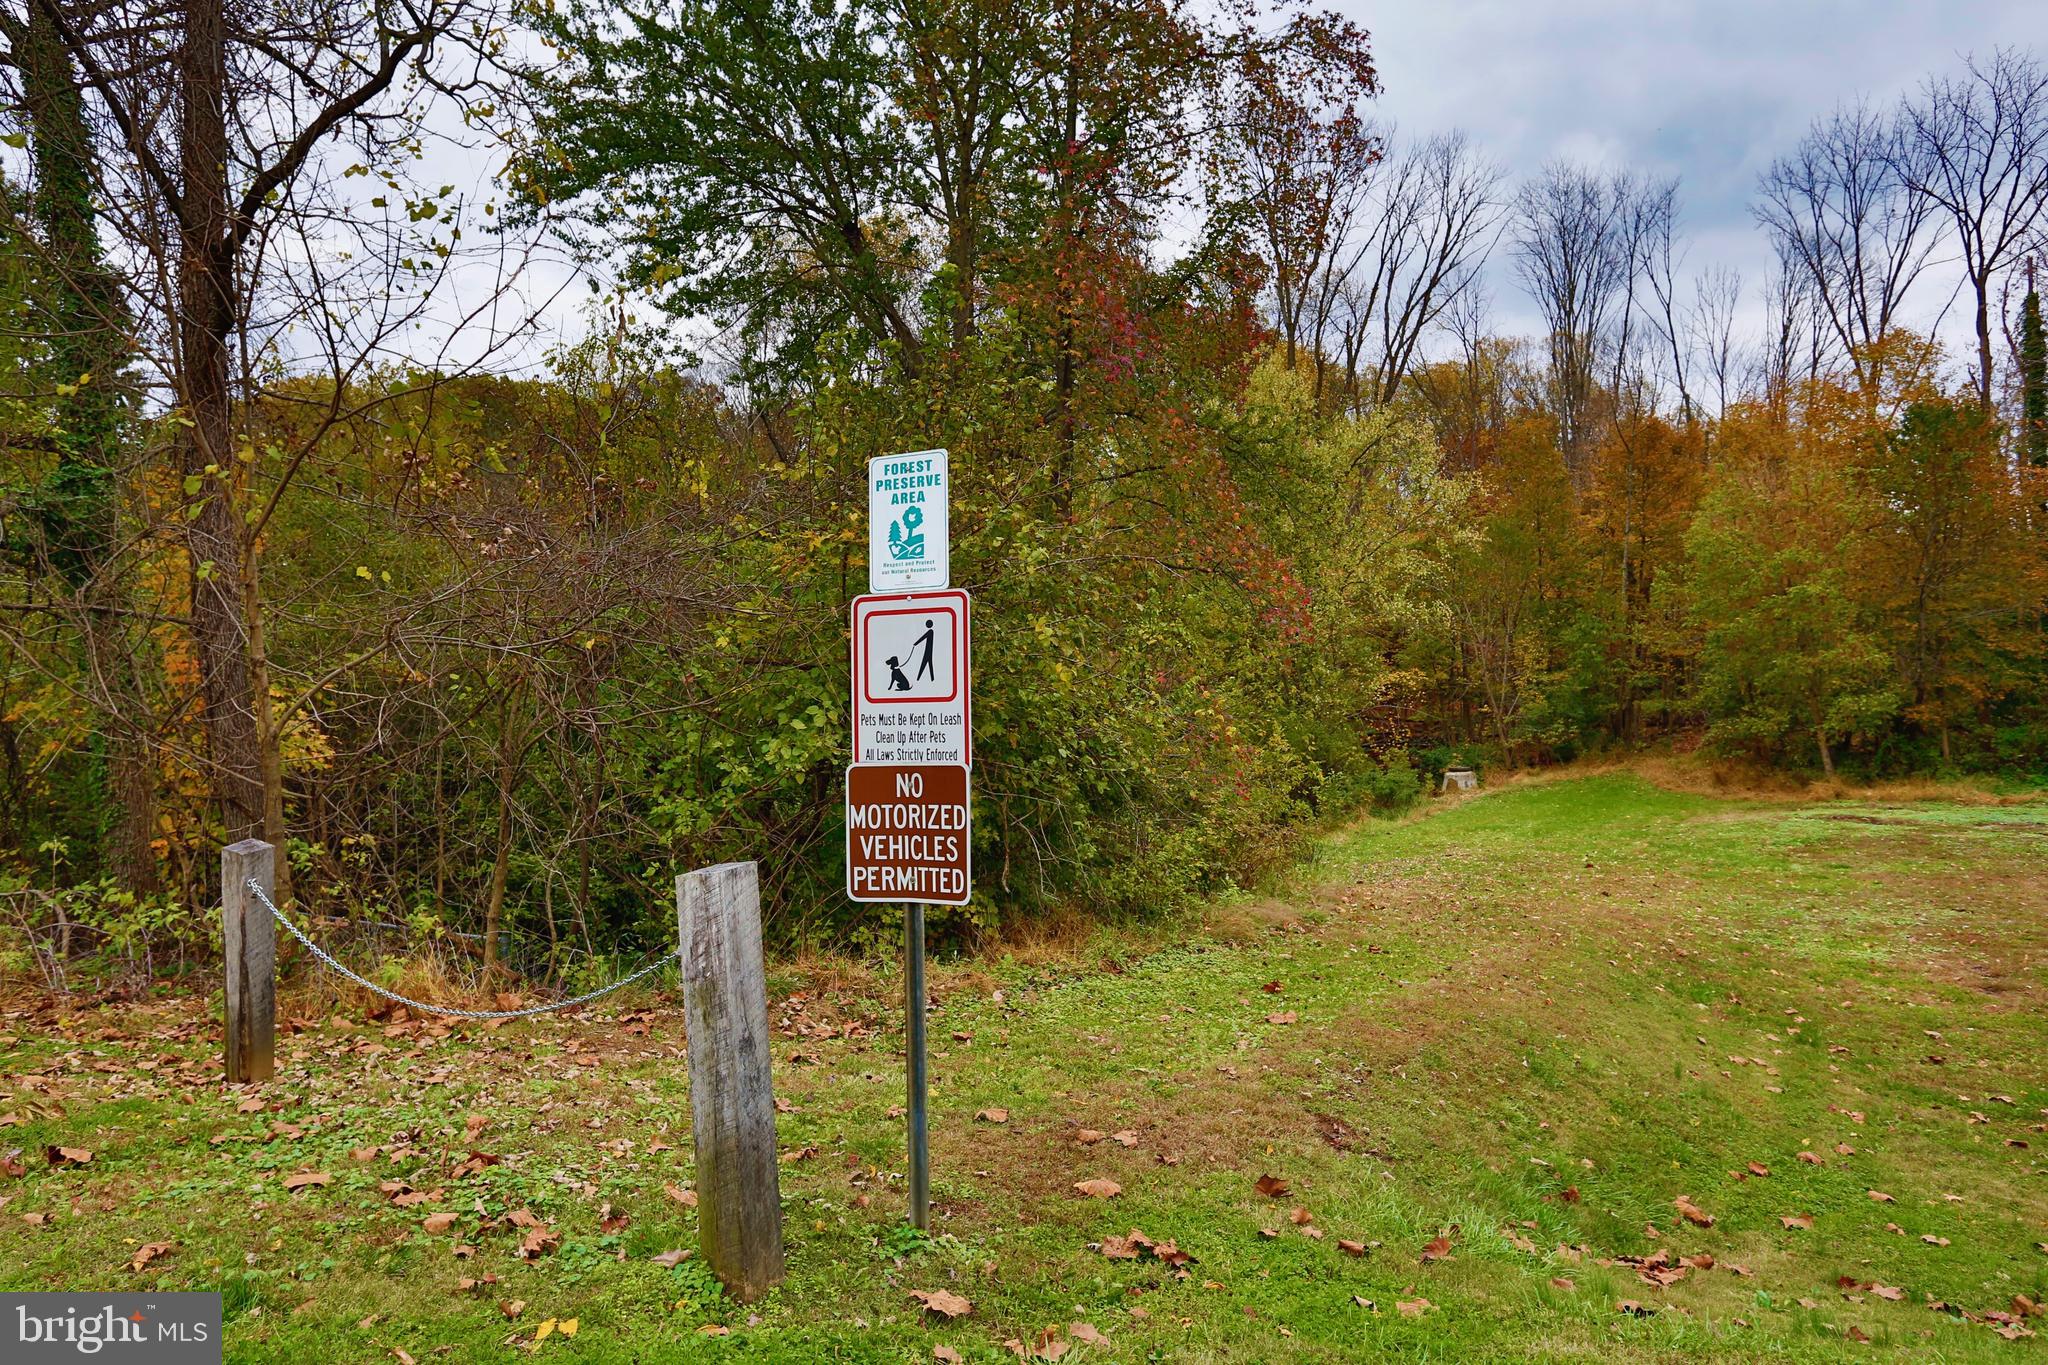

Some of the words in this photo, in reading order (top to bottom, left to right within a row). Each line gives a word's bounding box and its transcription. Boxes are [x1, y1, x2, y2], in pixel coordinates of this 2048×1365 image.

[884, 459, 933, 476] FOREST
[876, 473, 941, 492] PRESERVE
[891, 490, 926, 505] AREA
[860, 714, 876, 726] Pets
[879, 713, 895, 726] Must
[898, 713, 907, 726] Be
[910, 713, 925, 728] Kept
[928, 713, 938, 726] On
[940, 713, 962, 726] Leash
[876, 731, 895, 743] Clean
[897, 731, 906, 746] Up
[909, 730, 927, 743] After
[930, 731, 946, 743] Pets
[865, 748, 875, 761] All
[877, 748, 894, 761] Laws
[897, 748, 924, 762] Strictly
[926, 748, 958, 761] Enforced
[896, 772, 924, 798] NO
[850, 804, 966, 830] MOTORIZED
[860, 835, 958, 862] VEHICLES
[853, 866, 964, 894] PERMITTED
